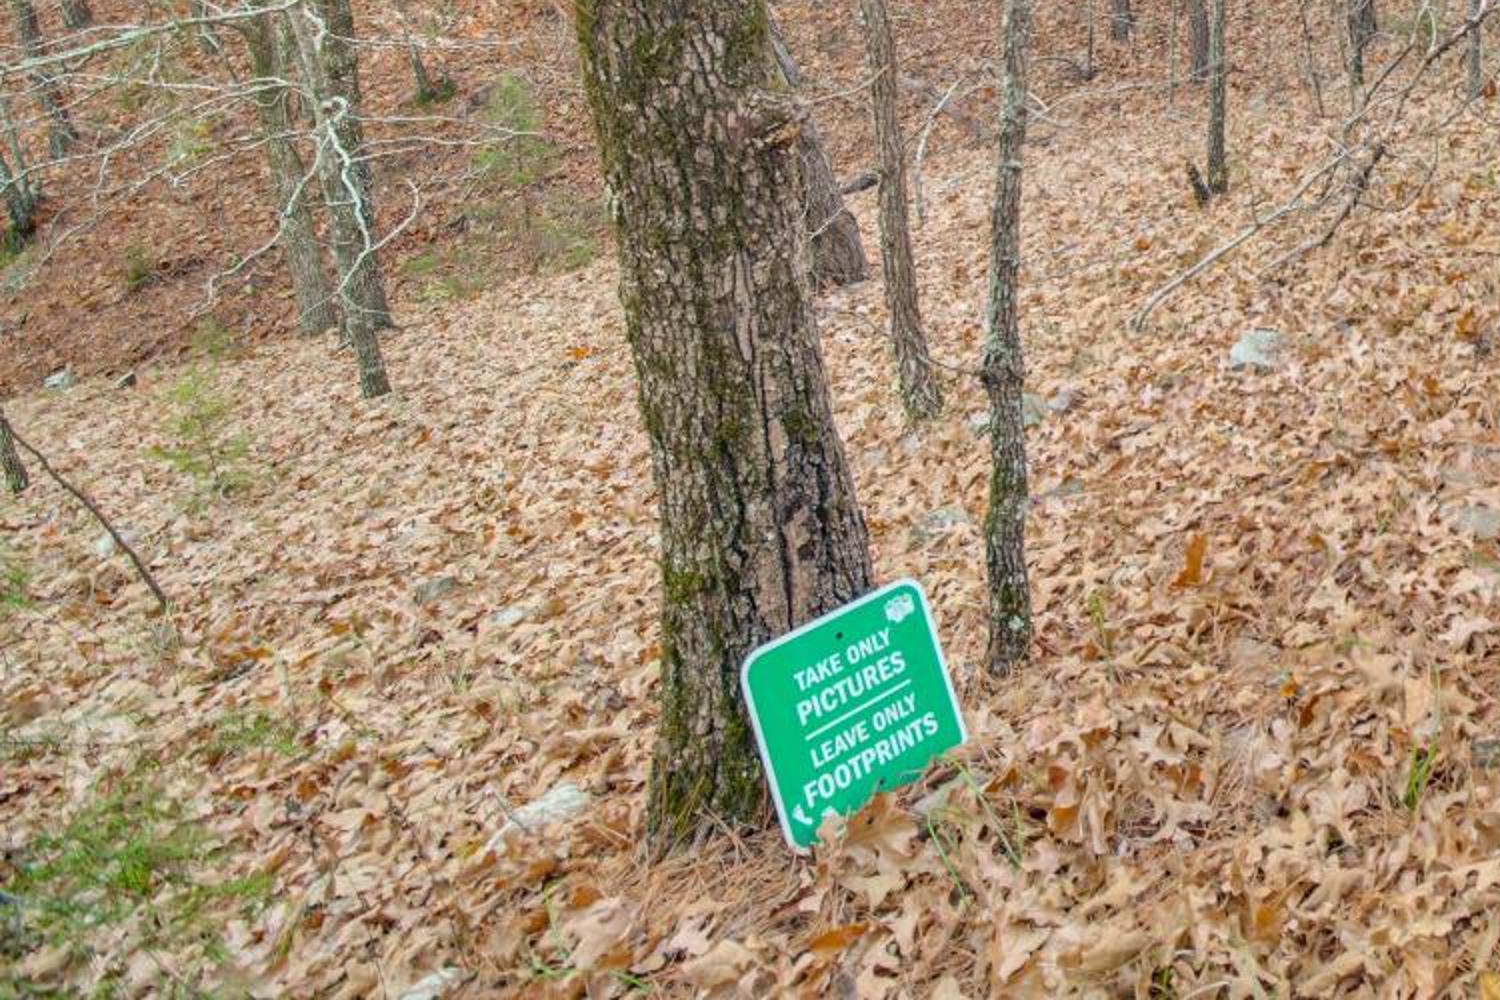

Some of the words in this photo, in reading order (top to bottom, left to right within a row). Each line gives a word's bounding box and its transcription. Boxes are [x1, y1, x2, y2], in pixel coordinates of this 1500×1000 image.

[793, 653, 843, 692] TAKE
[846, 628, 892, 664] ONLY
[796, 651, 907, 727] PICTURES
[803, 711, 939, 808] FOOTPRINTS
[809, 720, 870, 769] LEAVE
[872, 692, 916, 732] ONLY
